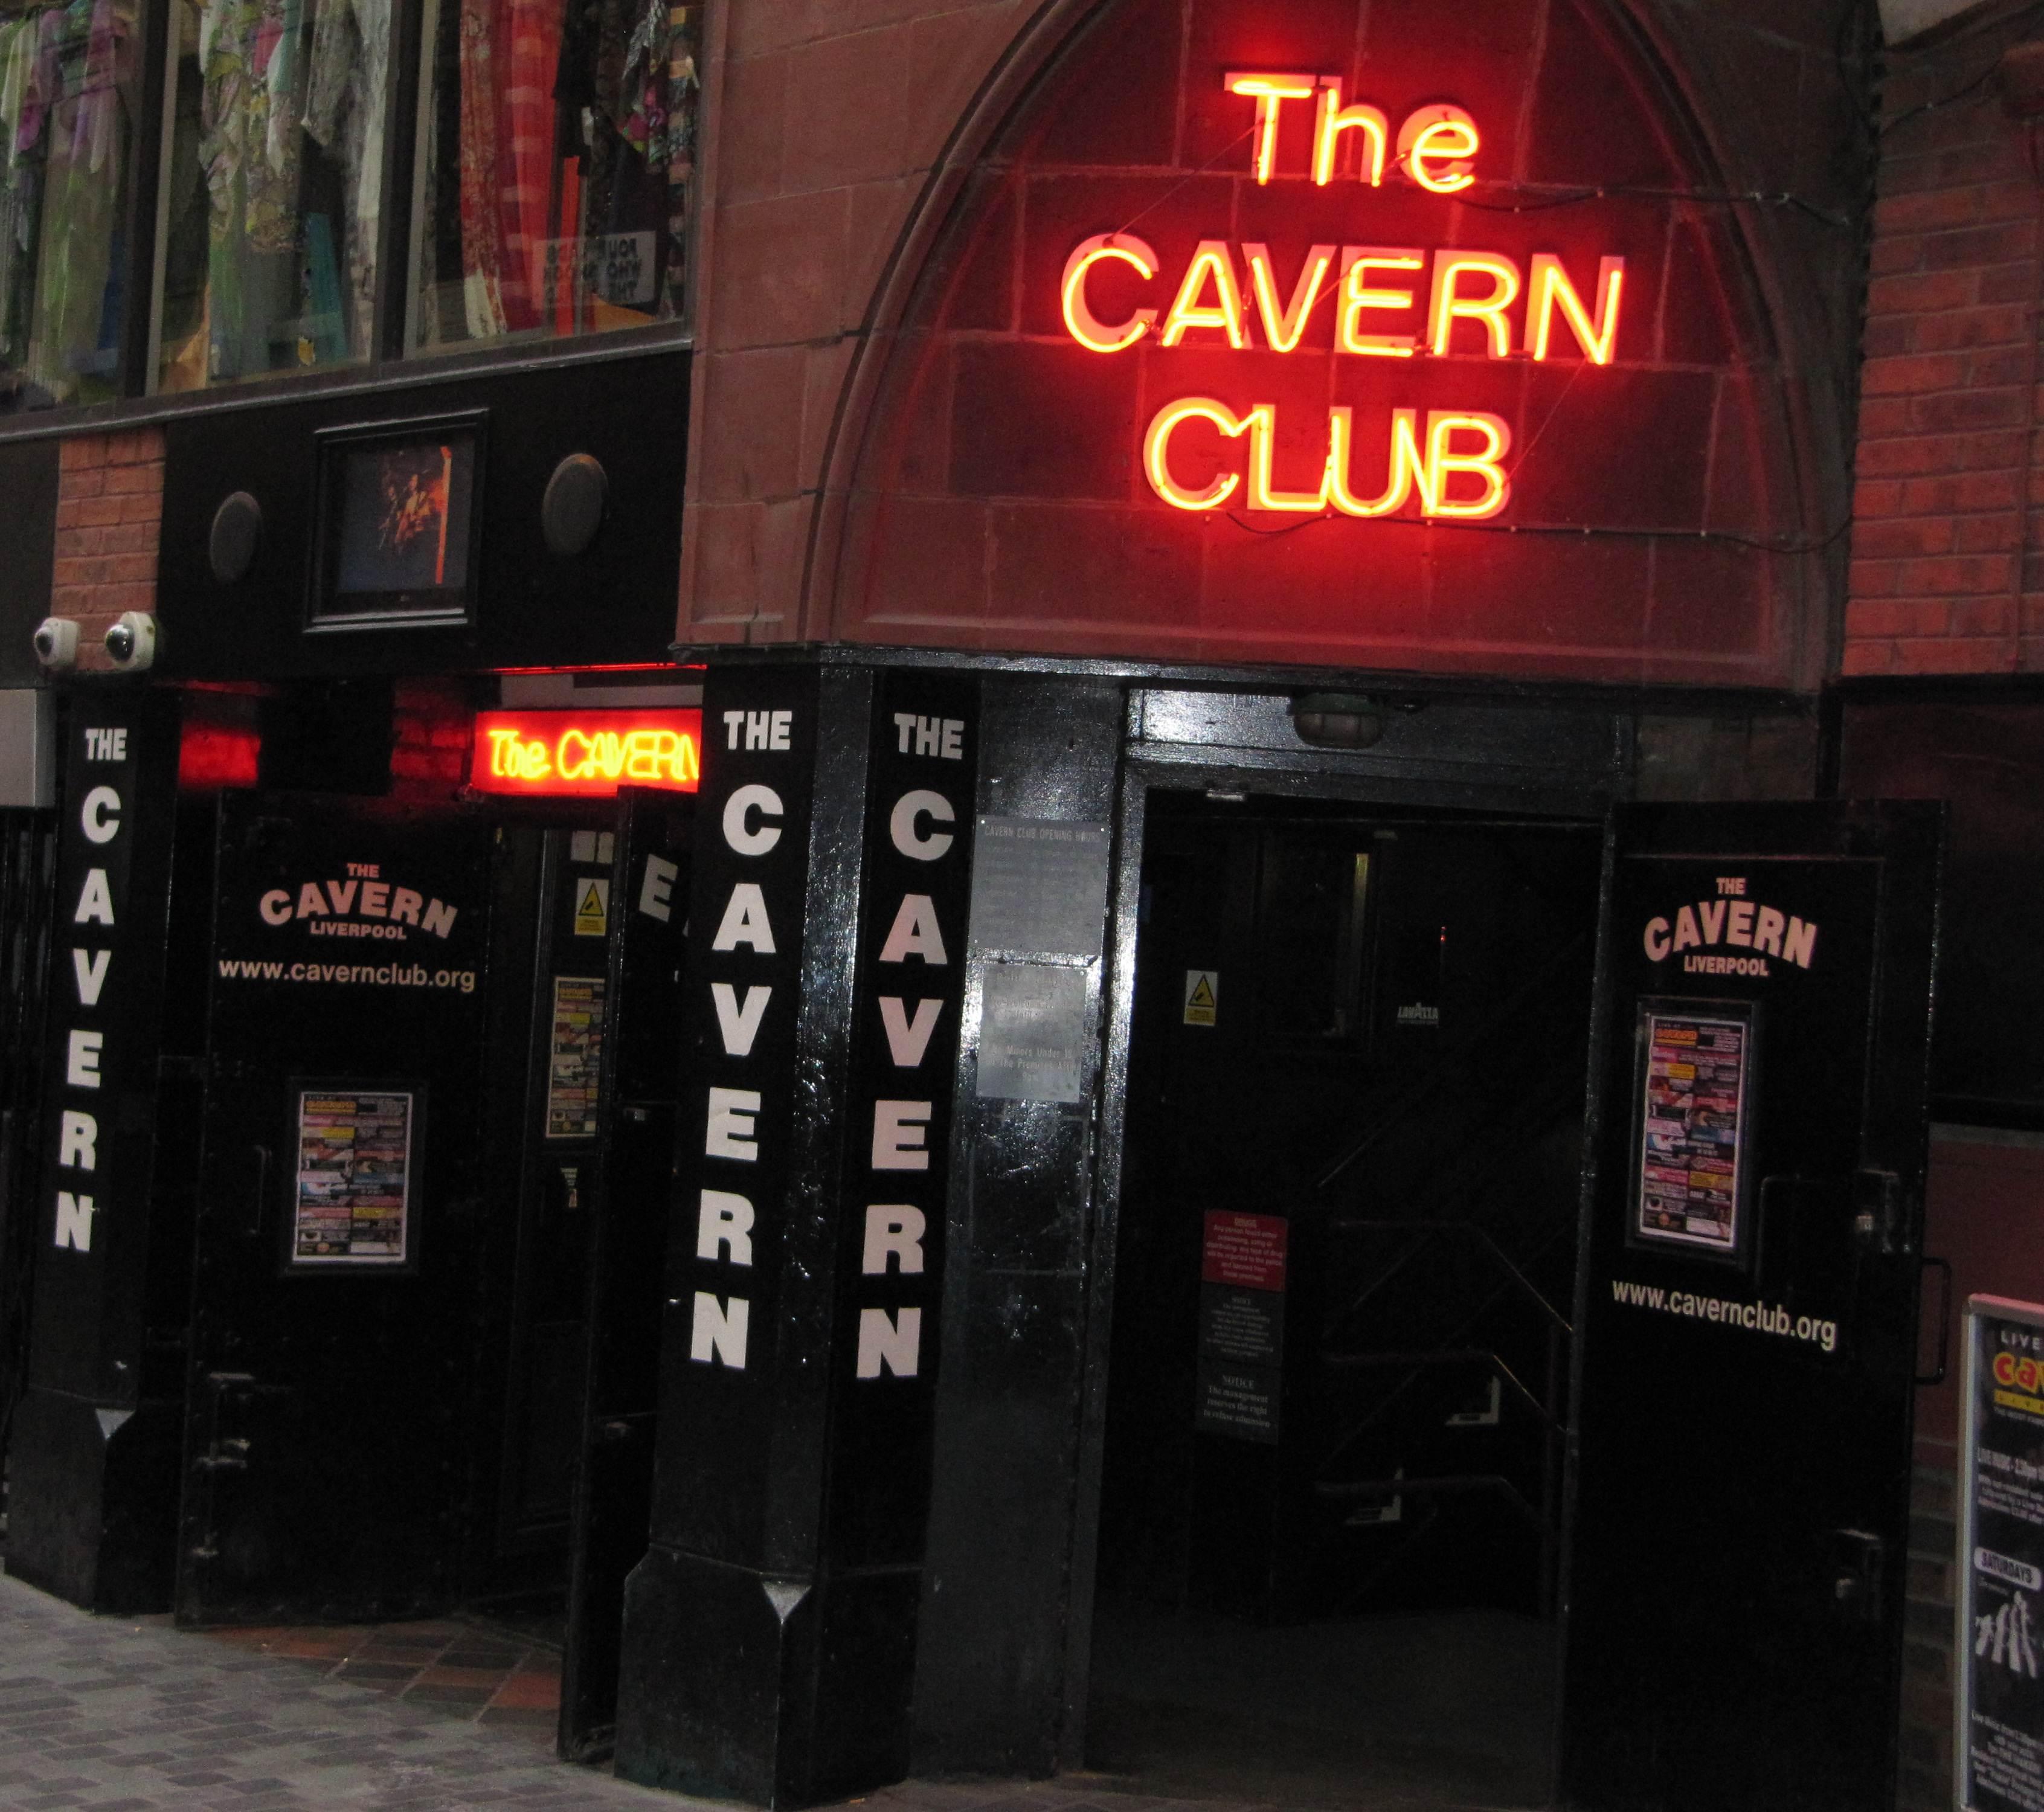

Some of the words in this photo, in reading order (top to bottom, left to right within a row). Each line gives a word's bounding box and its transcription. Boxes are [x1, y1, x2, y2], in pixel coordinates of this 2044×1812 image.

[1224, 72, 1479, 193] The
[1061, 233, 1625, 364] CAVERN
[1143, 396, 1512, 519] CLUB
[86, 728, 127, 761] THE
[723, 710, 792, 750] THE
[894, 713, 965, 760] THE
[985, 826, 1014, 837] CAVERN
[1017, 827, 1036, 839] CLUB
[1040, 828, 1072, 841] OPENING
[347, 863, 379, 878] THE
[1716, 878, 1746, 895] THE
[260, 880, 458, 939] CAVERN
[310, 921, 407, 940] LIVERPOOL
[1644, 900, 1817, 969] CAVERN
[219, 960, 475, 992] www.cavernclub.org
[1684, 955, 1769, 977] LIVERPOOL
[56, 786, 121, 1252] CAVERN
[690, 785, 783, 1369] CAVERN
[856, 789, 956, 1379] CAVERN
[1613, 1280, 1837, 1352] www.cavernclub.org
[2001, 1331, 2040, 1351] LIVE
[1993, 1352, 2044, 1394] ca
